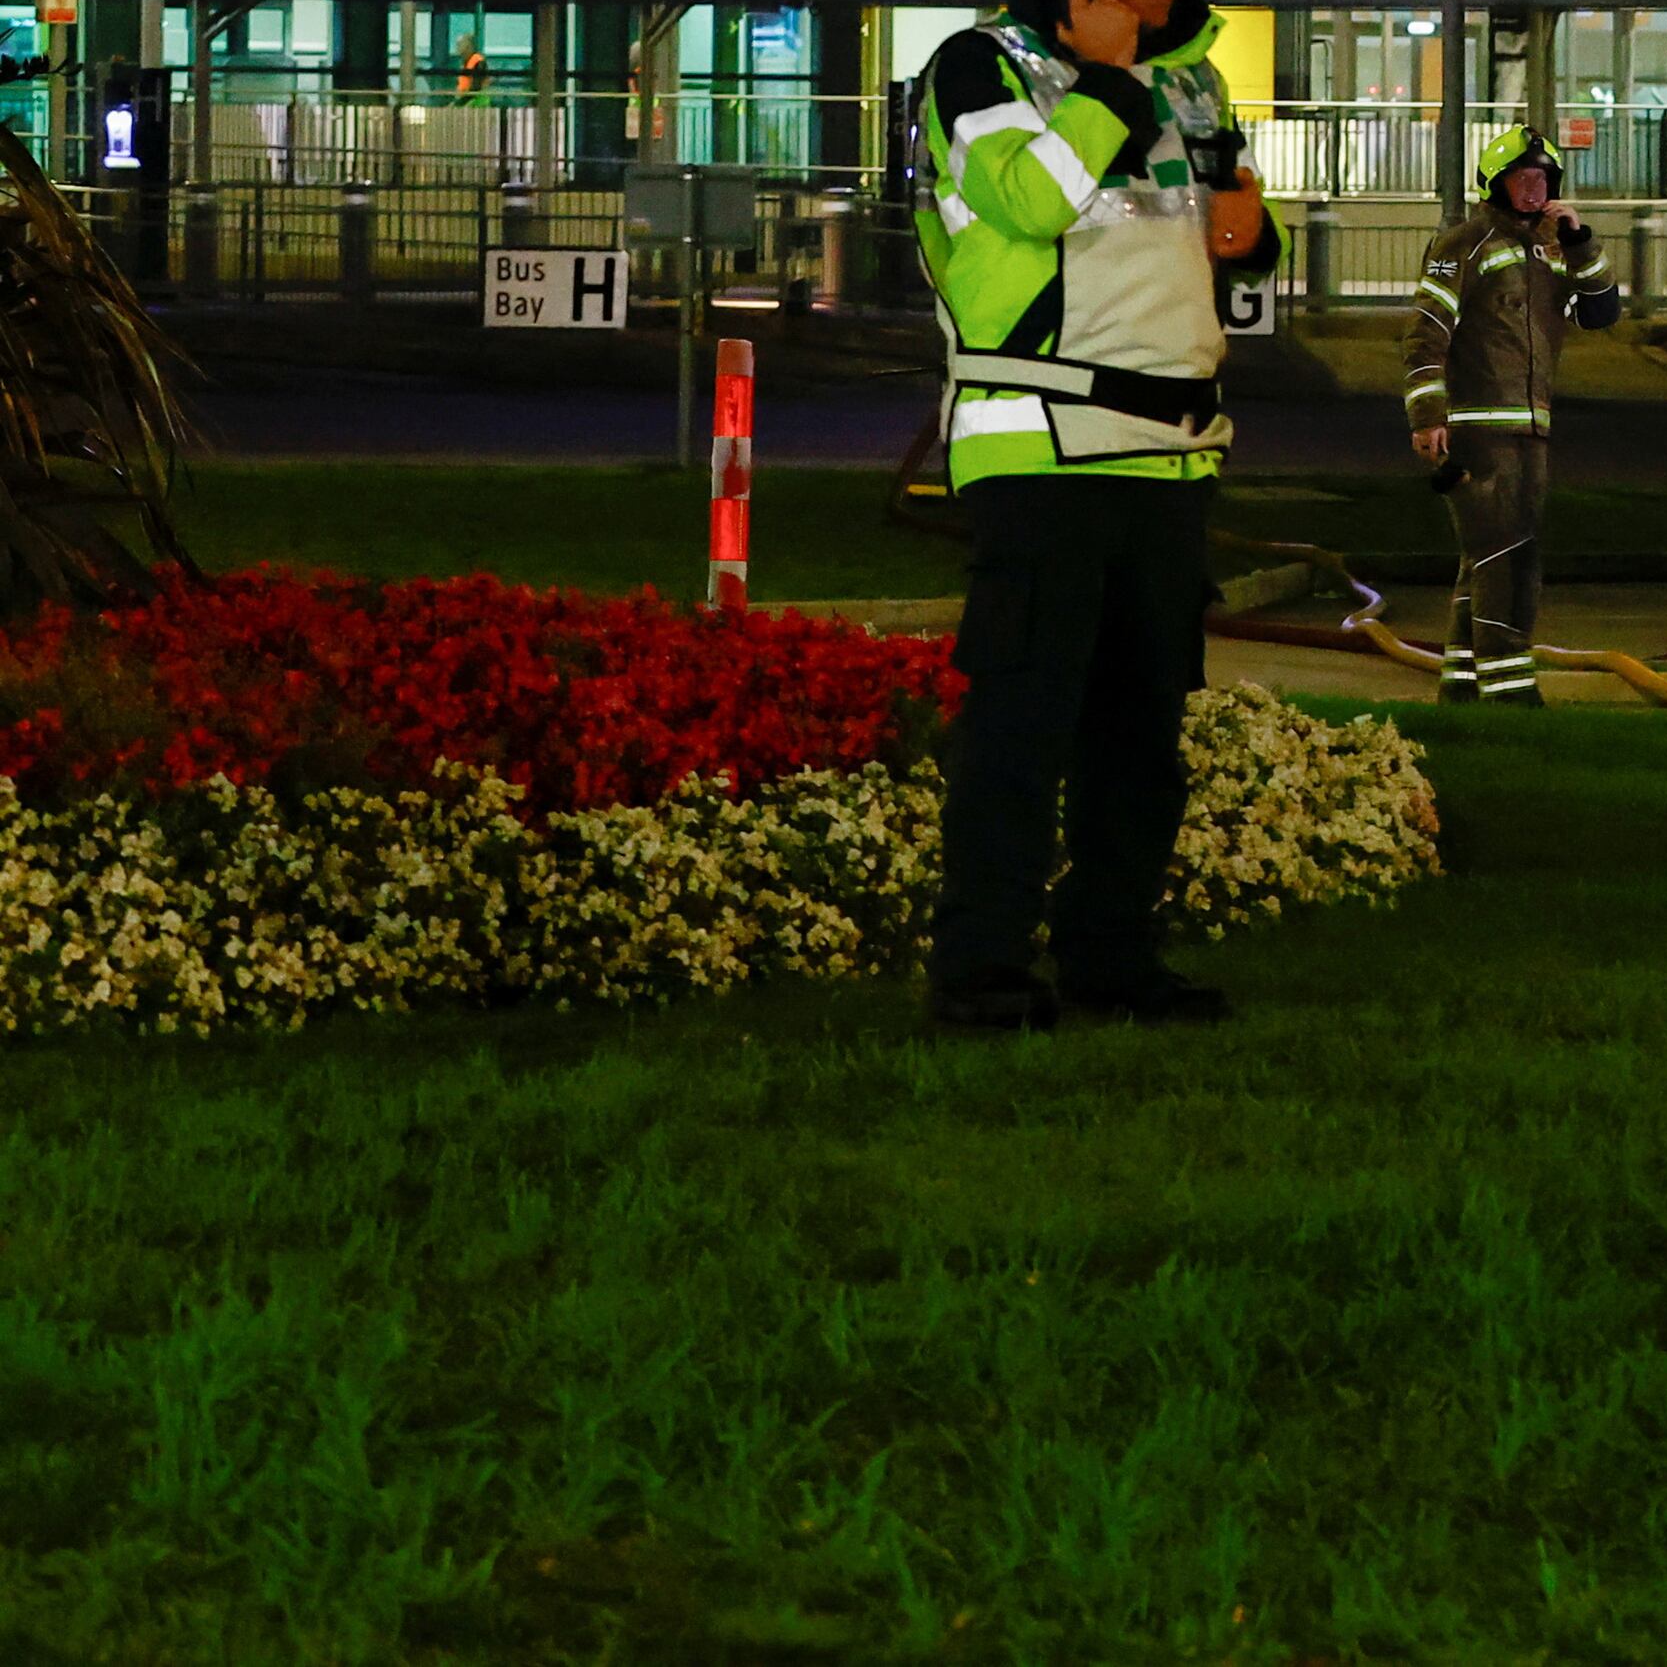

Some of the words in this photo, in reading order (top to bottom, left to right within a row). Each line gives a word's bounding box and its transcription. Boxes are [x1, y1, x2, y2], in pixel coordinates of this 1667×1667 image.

[497, 257, 545, 282] Bus
[496, 292, 544, 324] Bay
[572, 257, 615, 321] H
[1225, 284, 1262, 329] G
